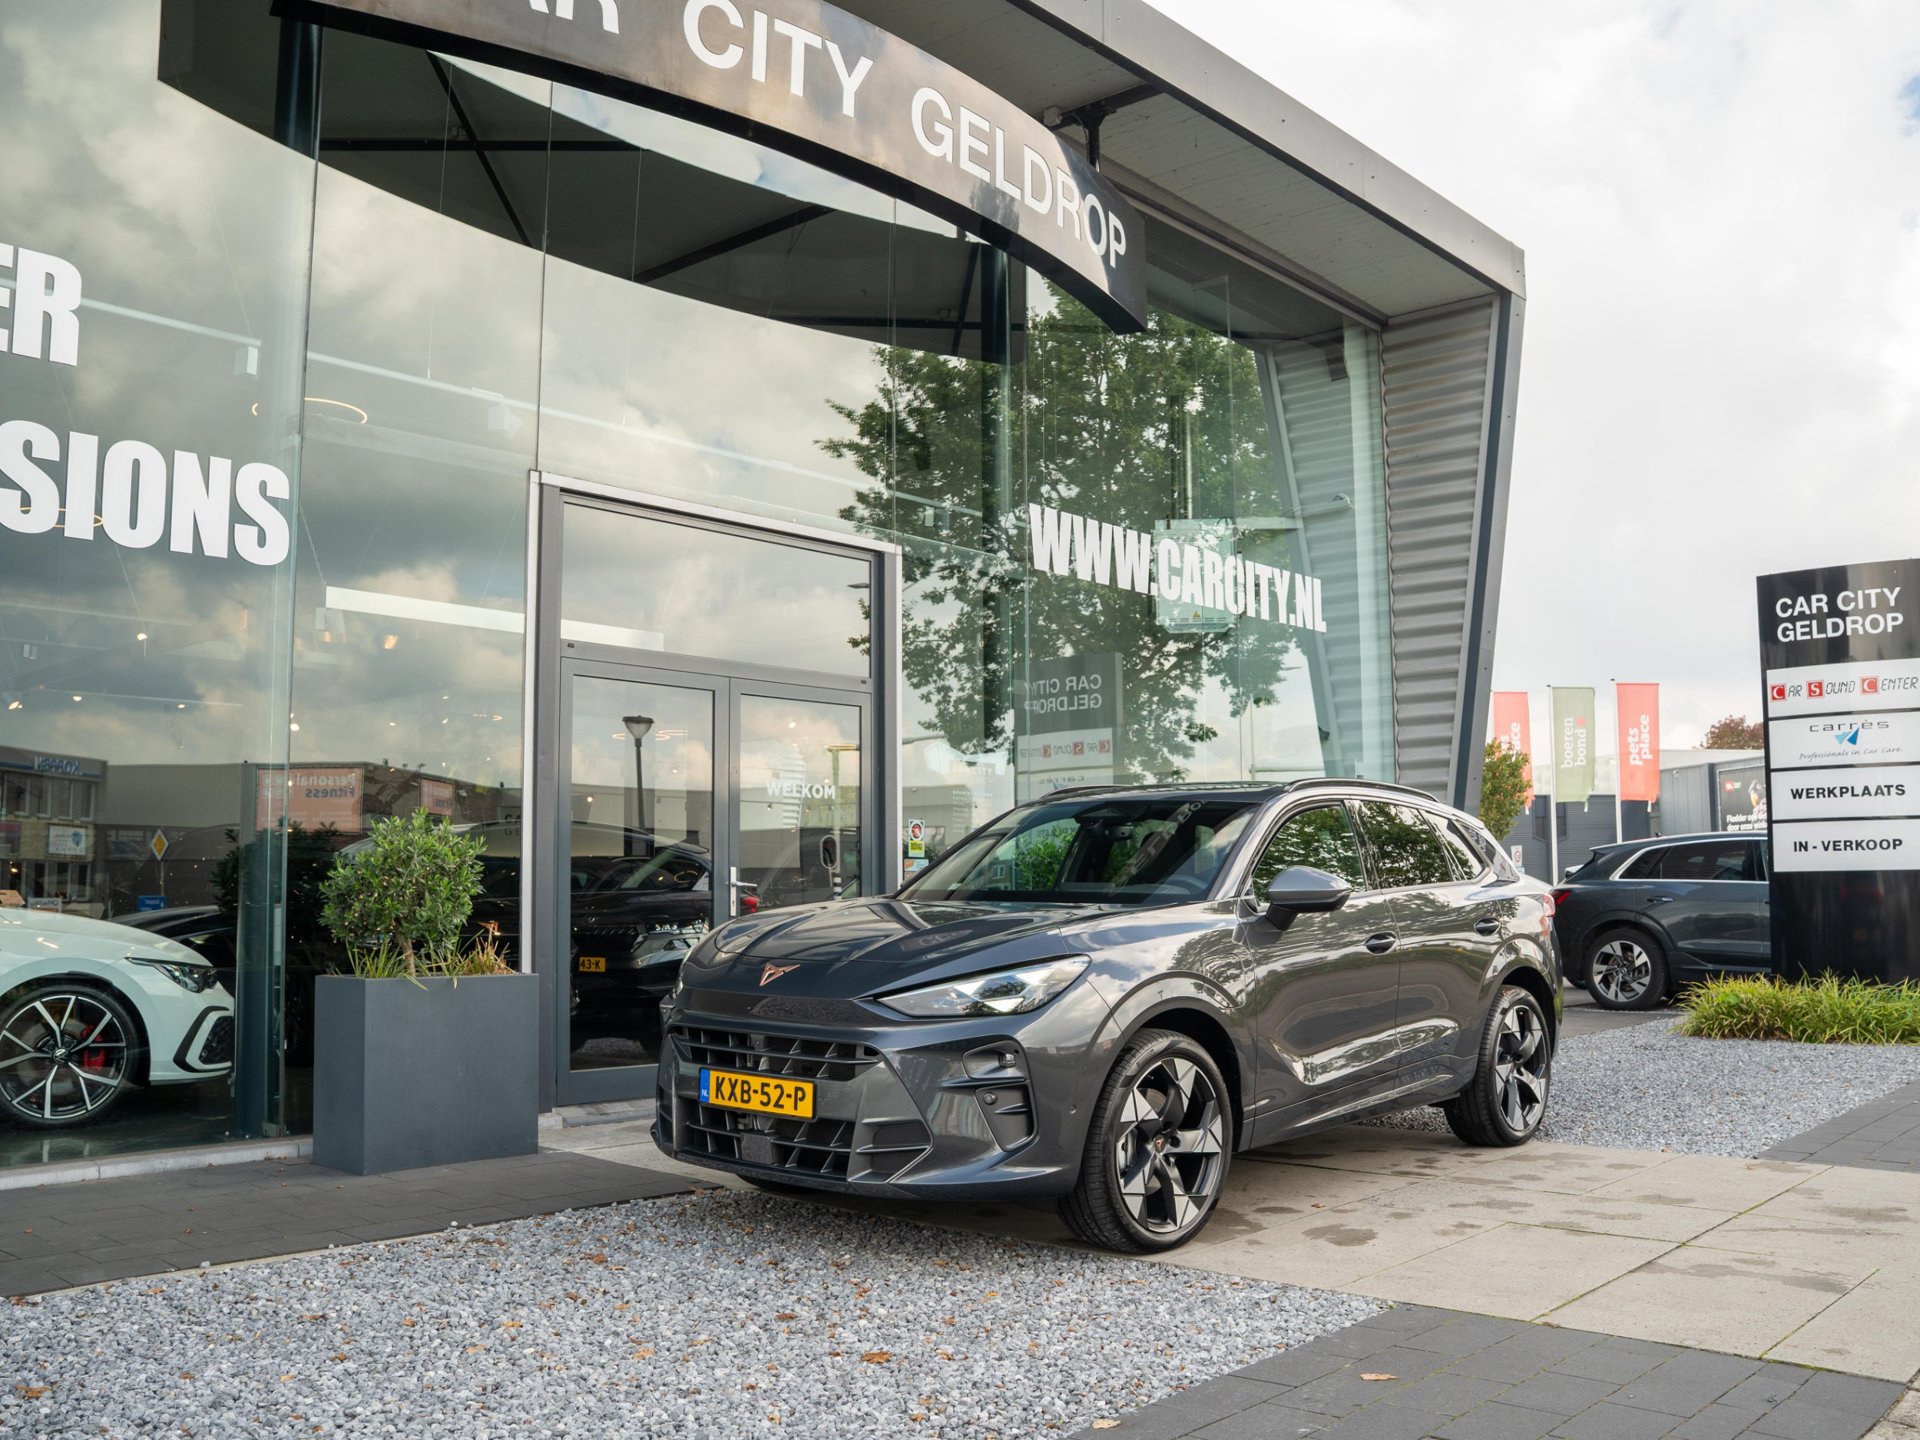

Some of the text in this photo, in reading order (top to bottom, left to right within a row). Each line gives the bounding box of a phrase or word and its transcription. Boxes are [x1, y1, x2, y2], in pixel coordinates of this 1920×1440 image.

[683, 0, 1126, 268] CITY GELDROP
[0, 420, 290, 565] SIONS
[1029, 503, 1327, 632] WWW.CARCITY.NL
[1776, 587, 1901, 618] CAR CITY
[1777, 612, 1904, 643] GELDROP
[1771, 676, 1919, 701] CAR SOUND CENTER
[1561, 717, 1574, 769] boeren
[1575, 729, 1587, 766] bond
[1627, 727, 1643, 766] pets
[1640, 714, 1653, 760] place
[766, 780, 836, 799] WELKOM
[1790, 784, 1906, 800] WERKPLAATS
[701, 1089, 709, 1097] NL
[715, 1075, 806, 1111] KXB-52-P
